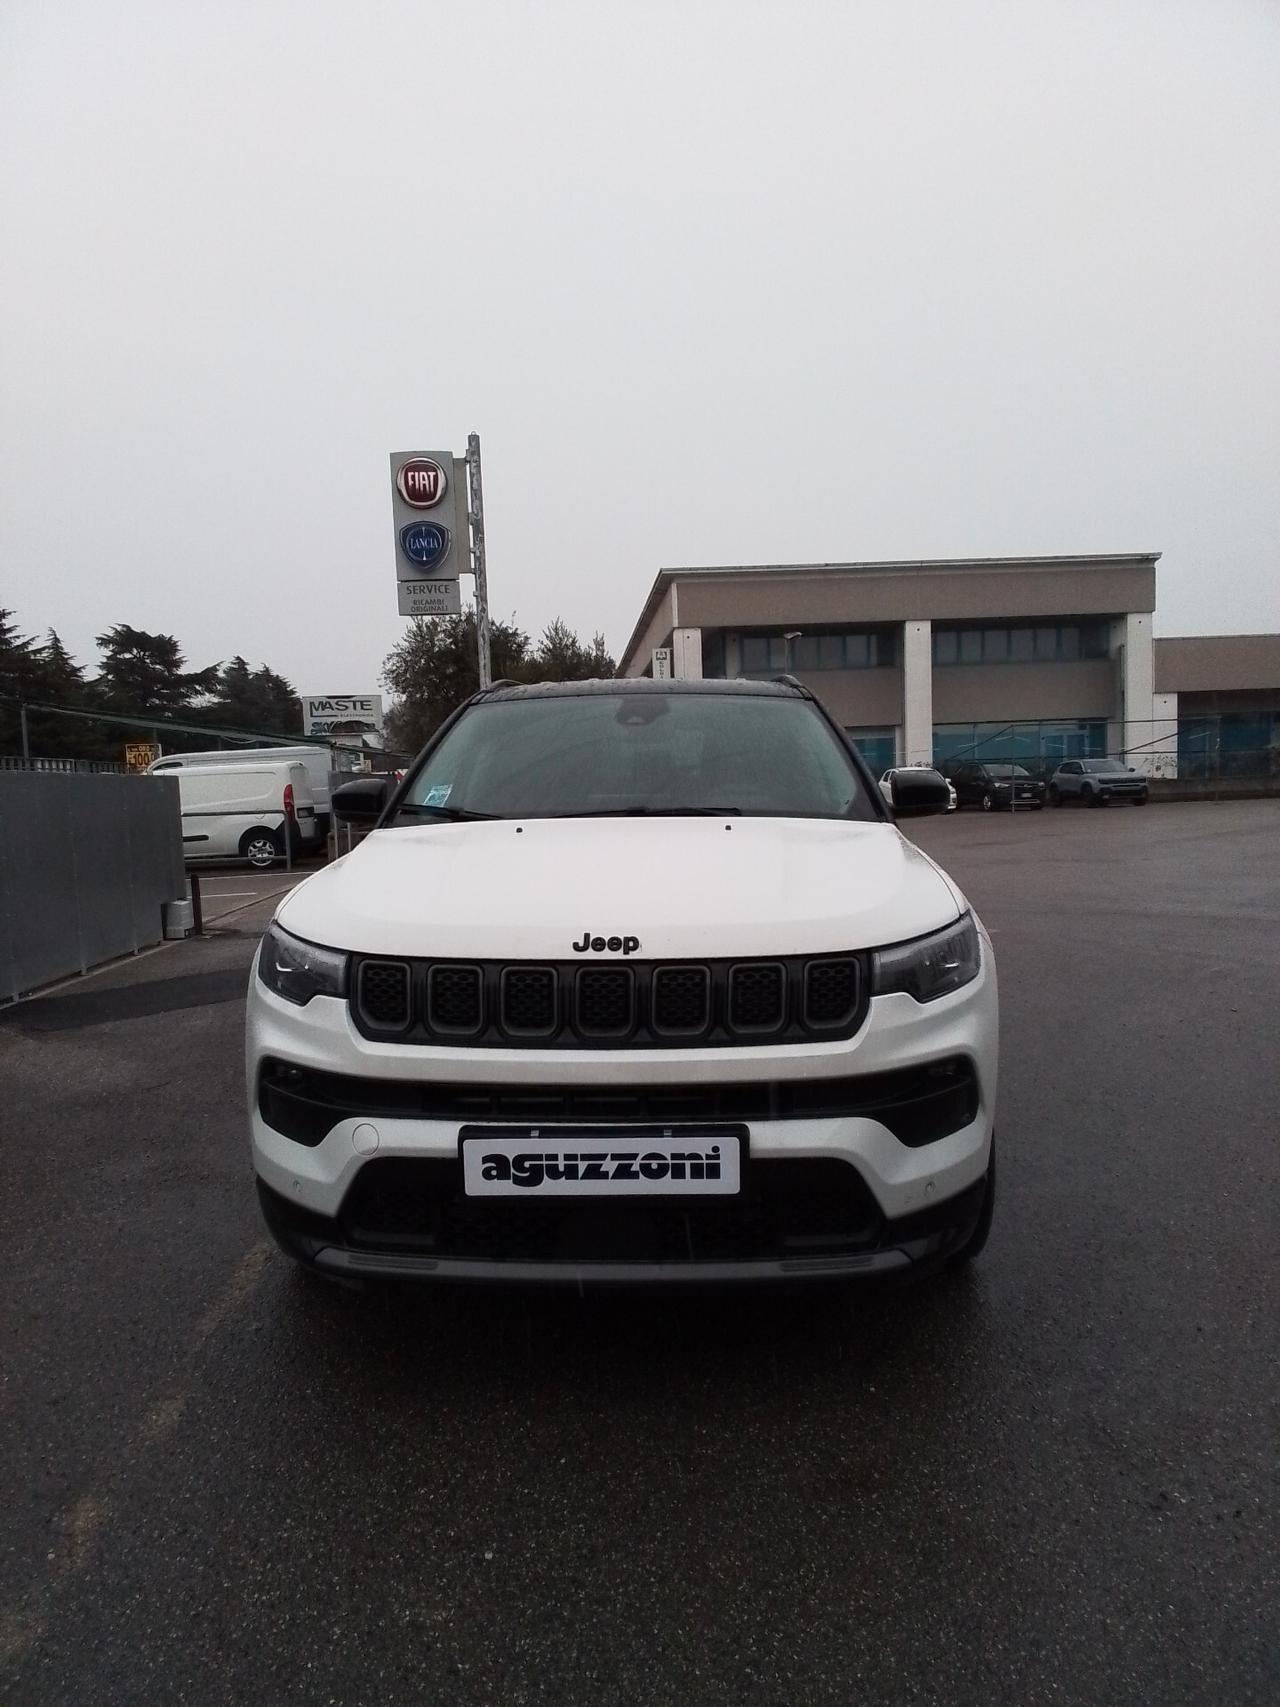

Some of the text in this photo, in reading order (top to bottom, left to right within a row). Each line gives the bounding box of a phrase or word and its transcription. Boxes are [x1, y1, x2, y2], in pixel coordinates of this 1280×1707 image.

[407, 471, 436, 494] FIAT
[410, 538, 438, 549] LANCIA
[406, 584, 451, 595] SERVICE
[413, 598, 445, 606] RICAMBI
[410, 605, 448, 613] ORIGINALI
[572, 932, 640, 955] Jeep
[481, 1145, 721, 1187] aguzzoni
